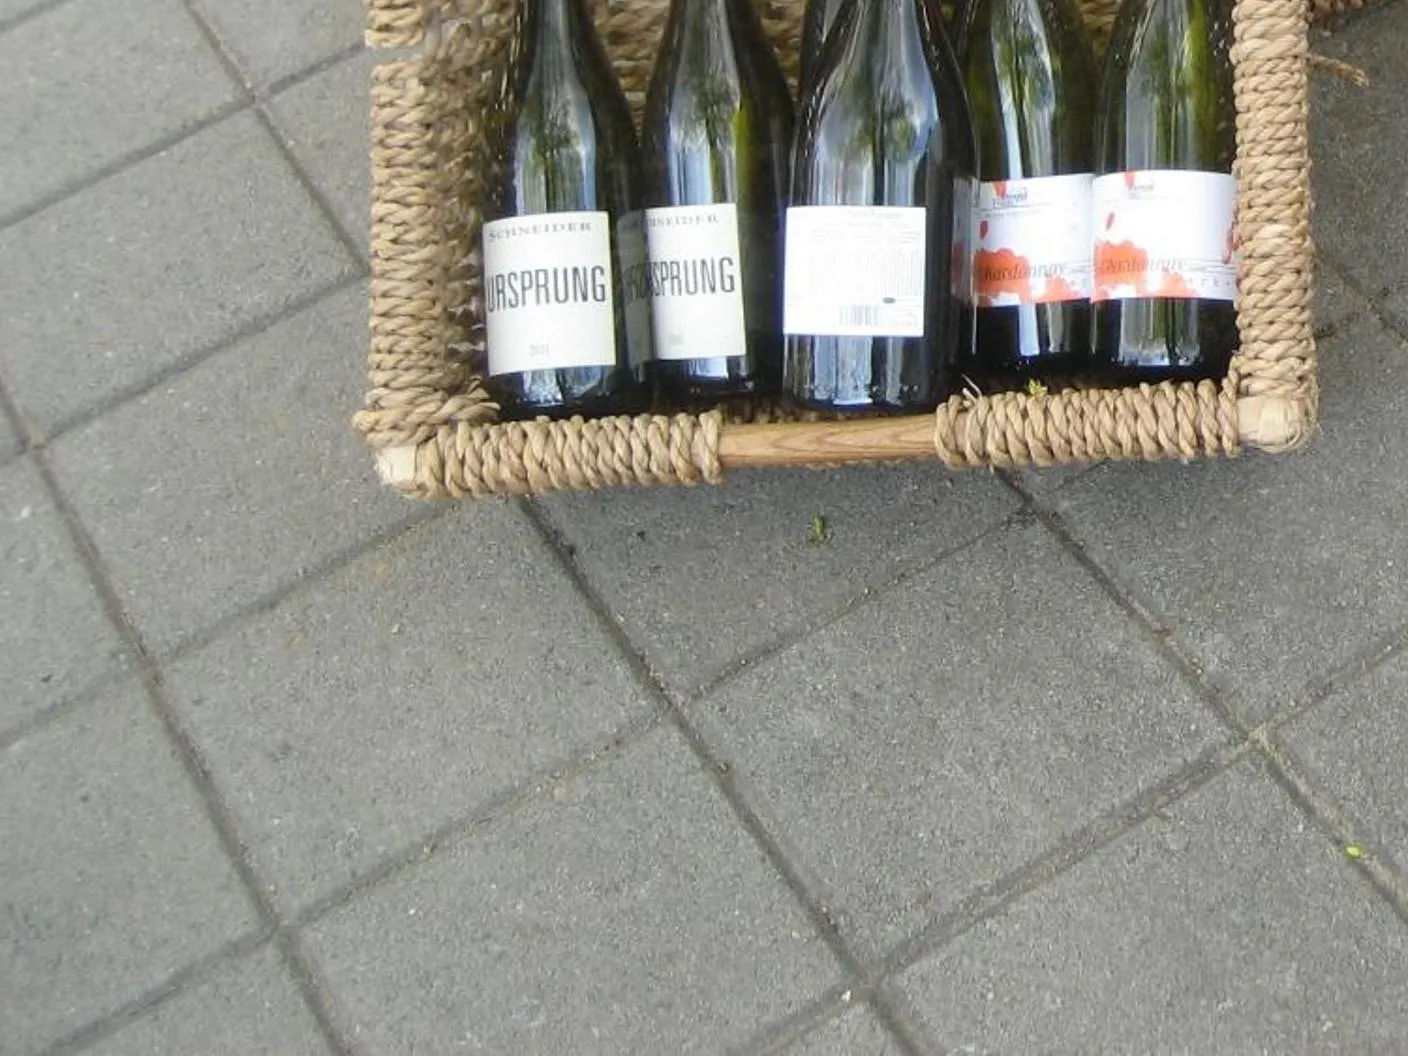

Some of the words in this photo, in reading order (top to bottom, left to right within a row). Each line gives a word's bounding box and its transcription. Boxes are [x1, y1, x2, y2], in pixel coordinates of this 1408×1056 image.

[488, 220, 593, 242] SCHNEIDER
[485, 264, 607, 314] URSPRUNG
[650, 256, 736, 298] SPRUNG
